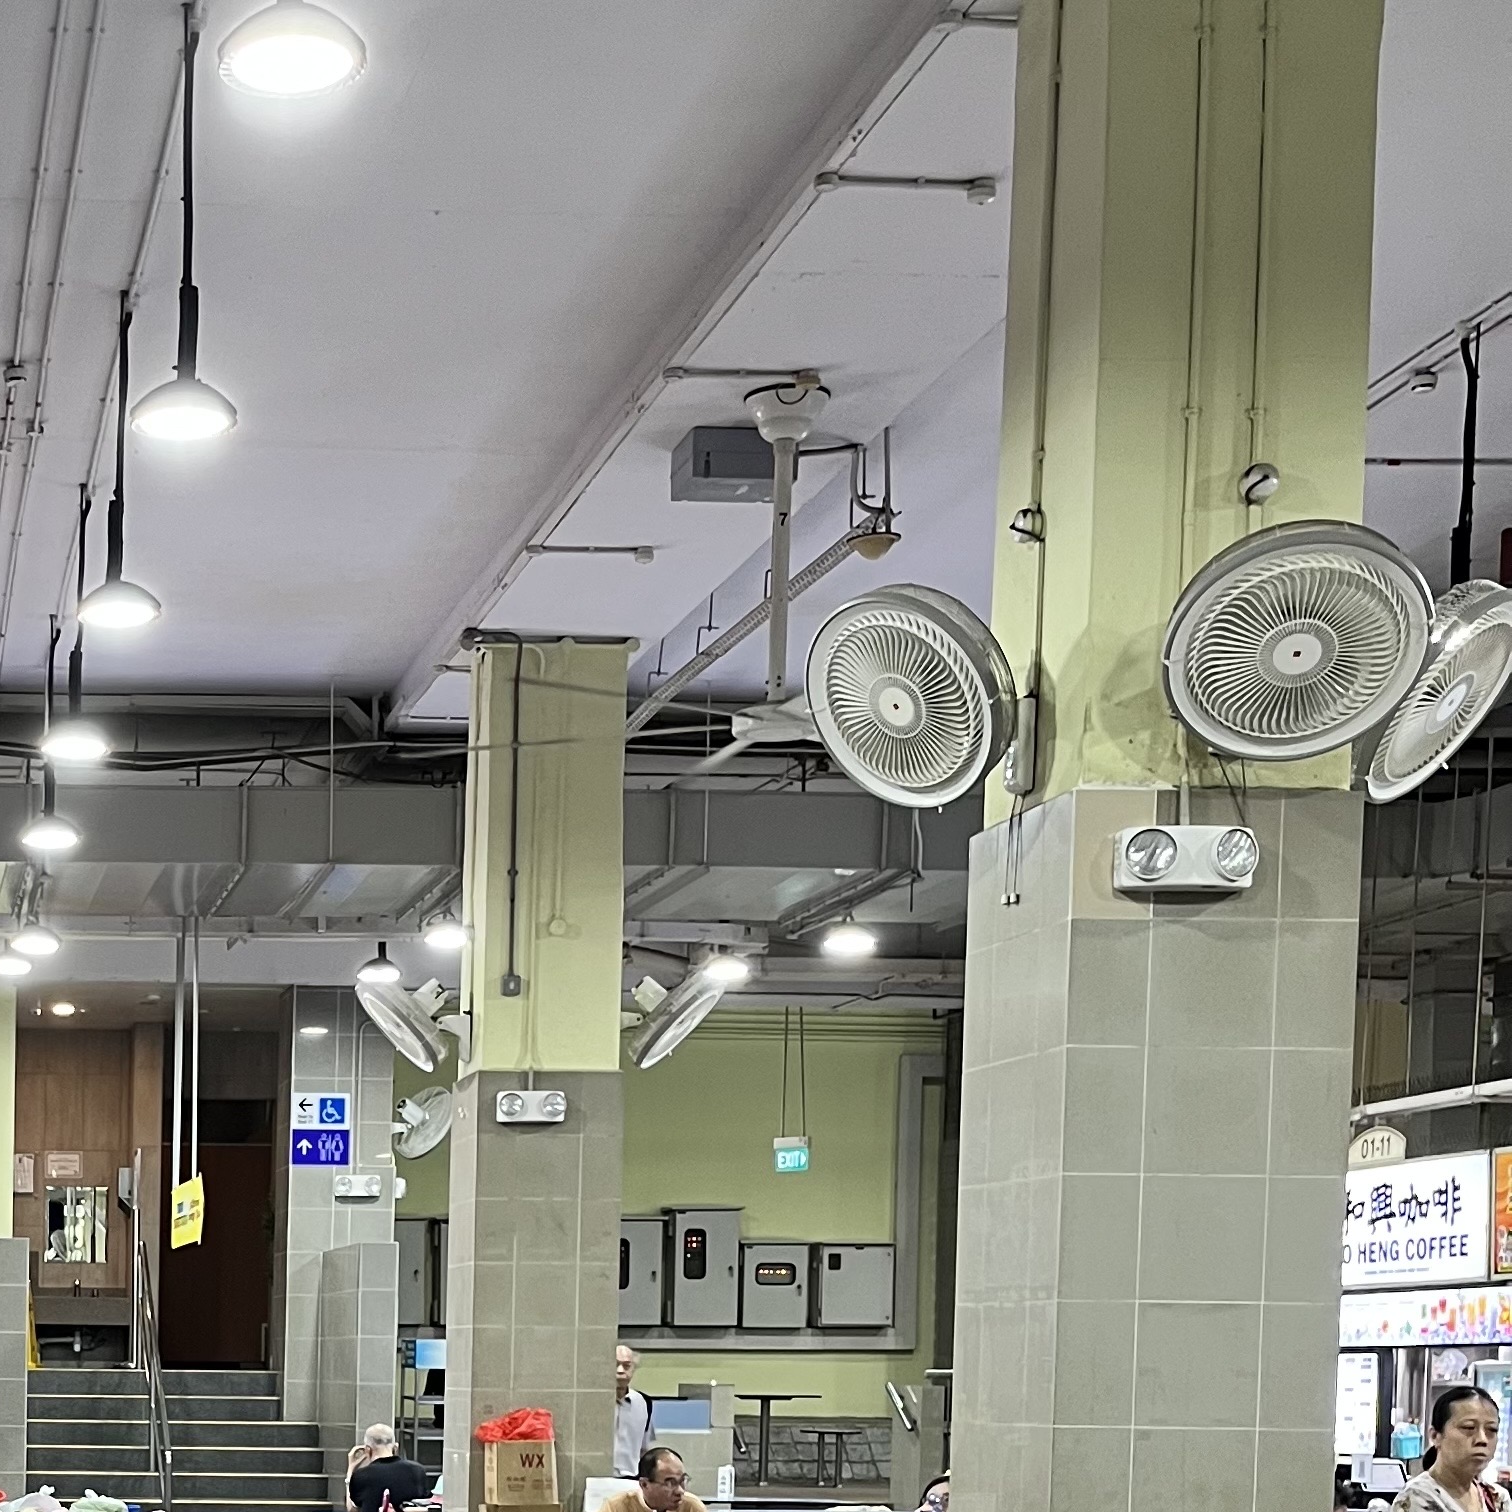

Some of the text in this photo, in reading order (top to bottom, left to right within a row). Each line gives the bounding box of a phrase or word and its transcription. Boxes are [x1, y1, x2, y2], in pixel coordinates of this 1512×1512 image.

[779, 513, 787, 526] 7
[777, 1151, 800, 1168] EXIT
[1358, 1239, 1400, 1265] HENG
[1405, 1233, 1469, 1262] COFFEE
[520, 1453, 545, 1469] WX
